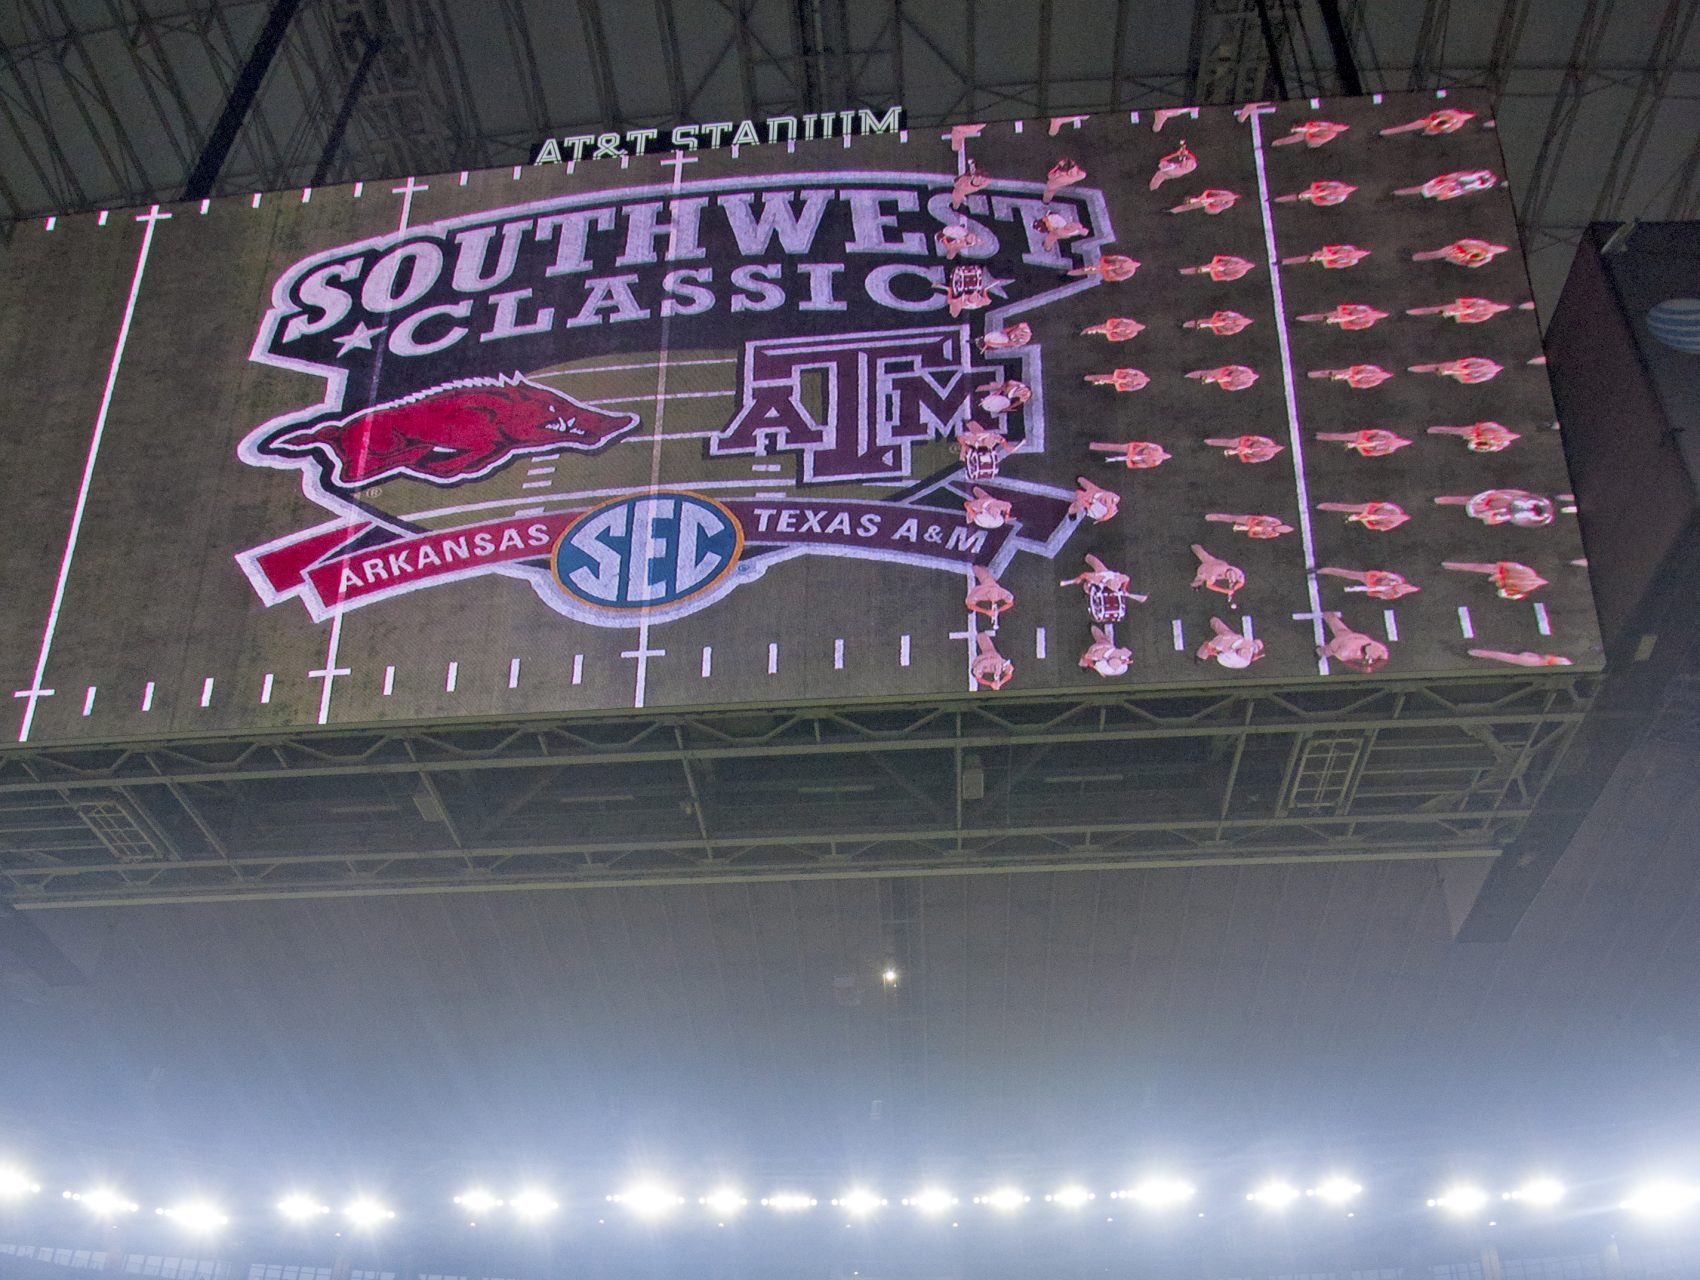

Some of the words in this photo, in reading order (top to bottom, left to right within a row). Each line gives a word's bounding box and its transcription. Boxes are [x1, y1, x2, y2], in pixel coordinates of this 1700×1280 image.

[534, 126, 658, 166] AT&T
[671, 106, 902, 152] STADIUM
[282, 188, 1089, 343] SOUTHWEST
[388, 262, 949, 357] CLASSIC
[338, 522, 551, 593] ARKANSAS
[568, 499, 726, 601] SEC
[752, 508, 882, 538] TEXAS
[891, 519, 988, 554] A&M
